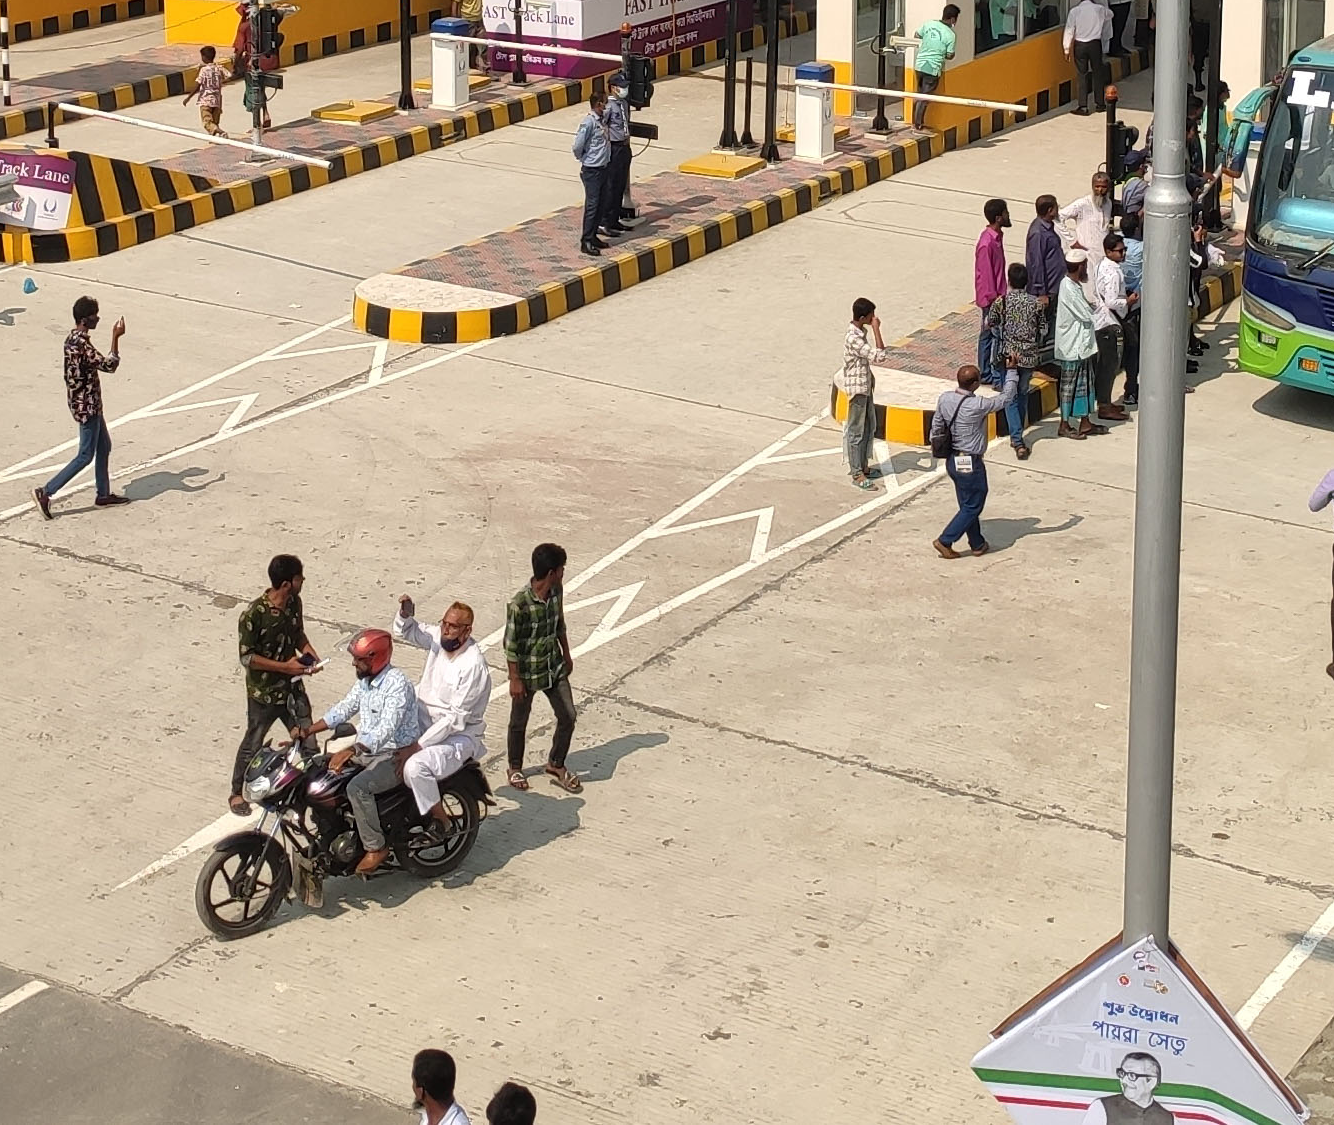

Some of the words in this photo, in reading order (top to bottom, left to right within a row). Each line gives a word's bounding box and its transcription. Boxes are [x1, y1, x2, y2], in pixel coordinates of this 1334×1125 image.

[483, 5, 507, 19] AST
[546, 10, 575, 25] Lane
[33, 164, 70, 184] Lane
[1103, 1001, 1126, 1016] শুভ
[1128, 1003, 1179, 1025] উদ্বোধন
[1092, 1020, 1140, 1045] পায়রা
[1148, 1031, 1189, 1057] সেতু
